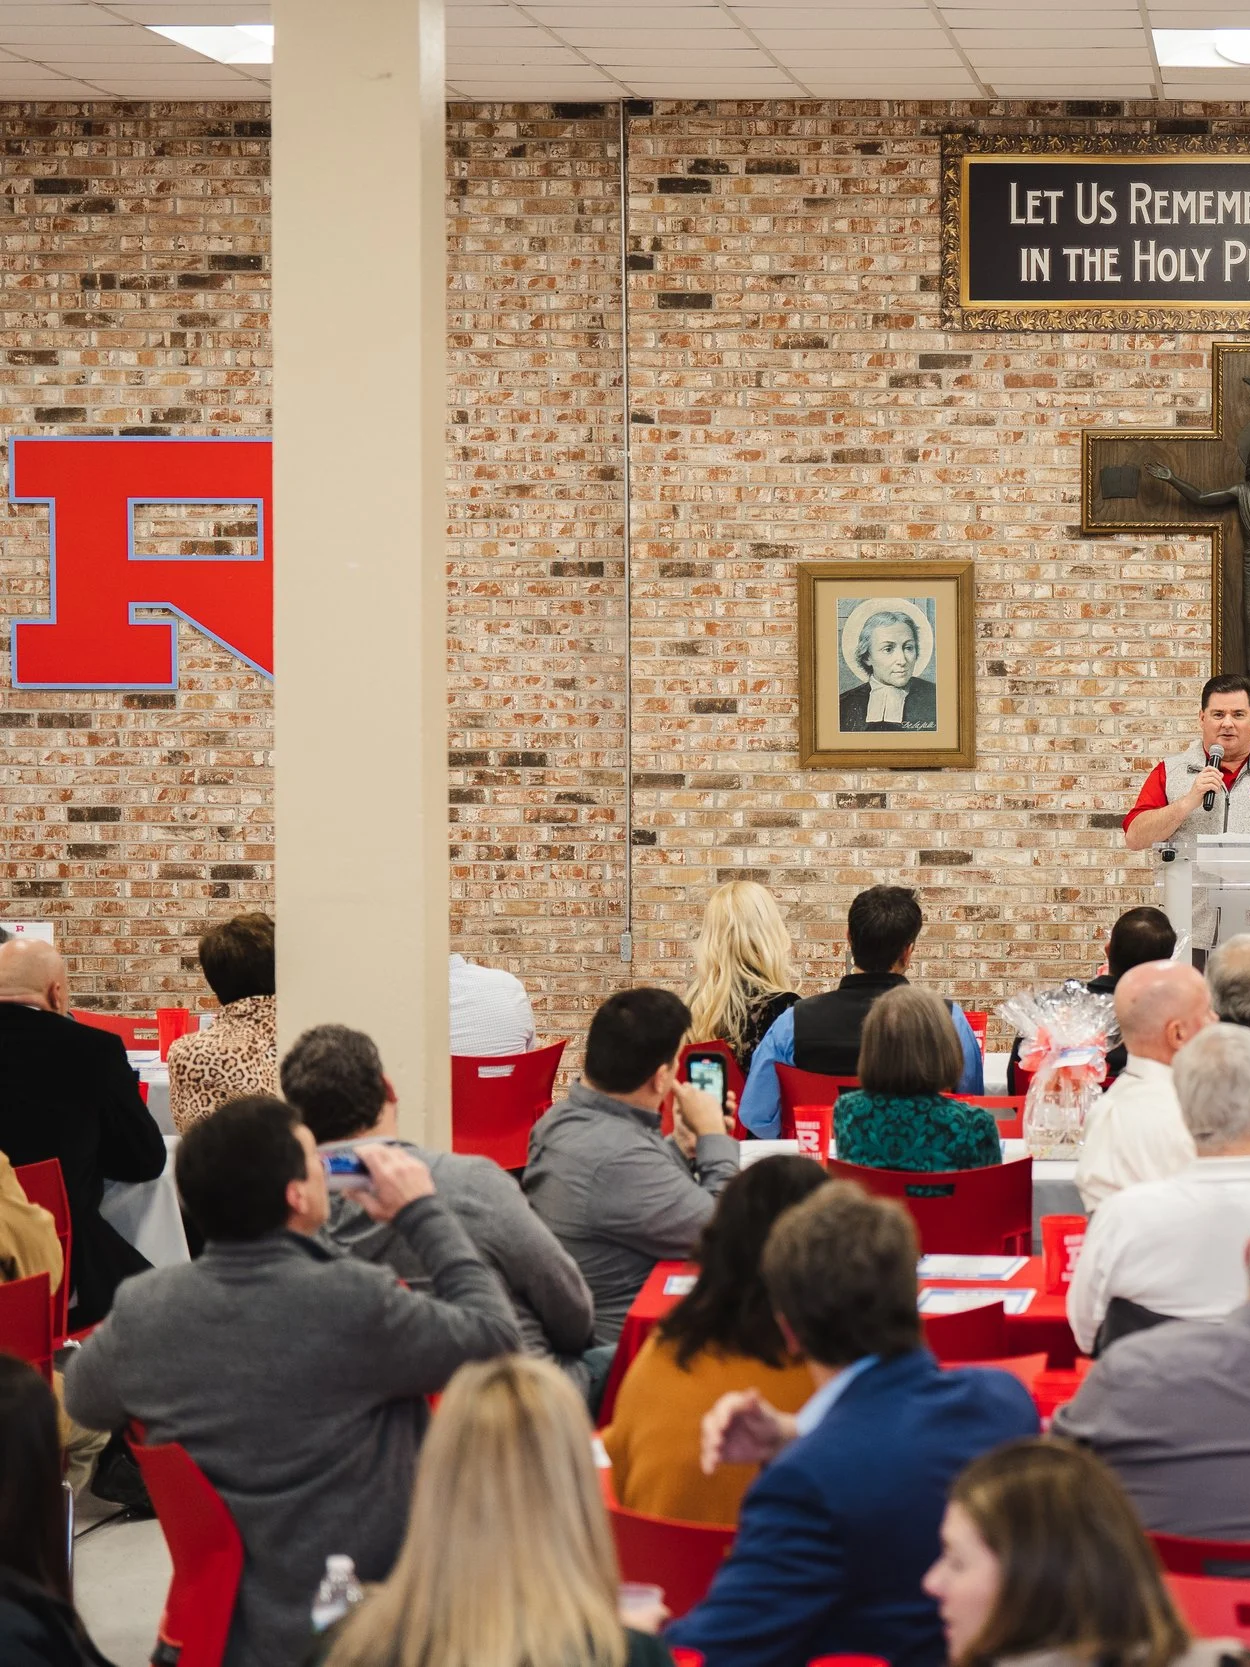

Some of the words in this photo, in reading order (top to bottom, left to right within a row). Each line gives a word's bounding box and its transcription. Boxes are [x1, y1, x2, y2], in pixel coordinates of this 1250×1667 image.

[1009, 181, 1065, 226] LET
[1075, 181, 1119, 226] US
[1019, 246, 1052, 283] IN
[1061, 246, 1123, 284] THE
[1132, 239, 1214, 284] HOLY
[796, 1130, 820, 1152] R
